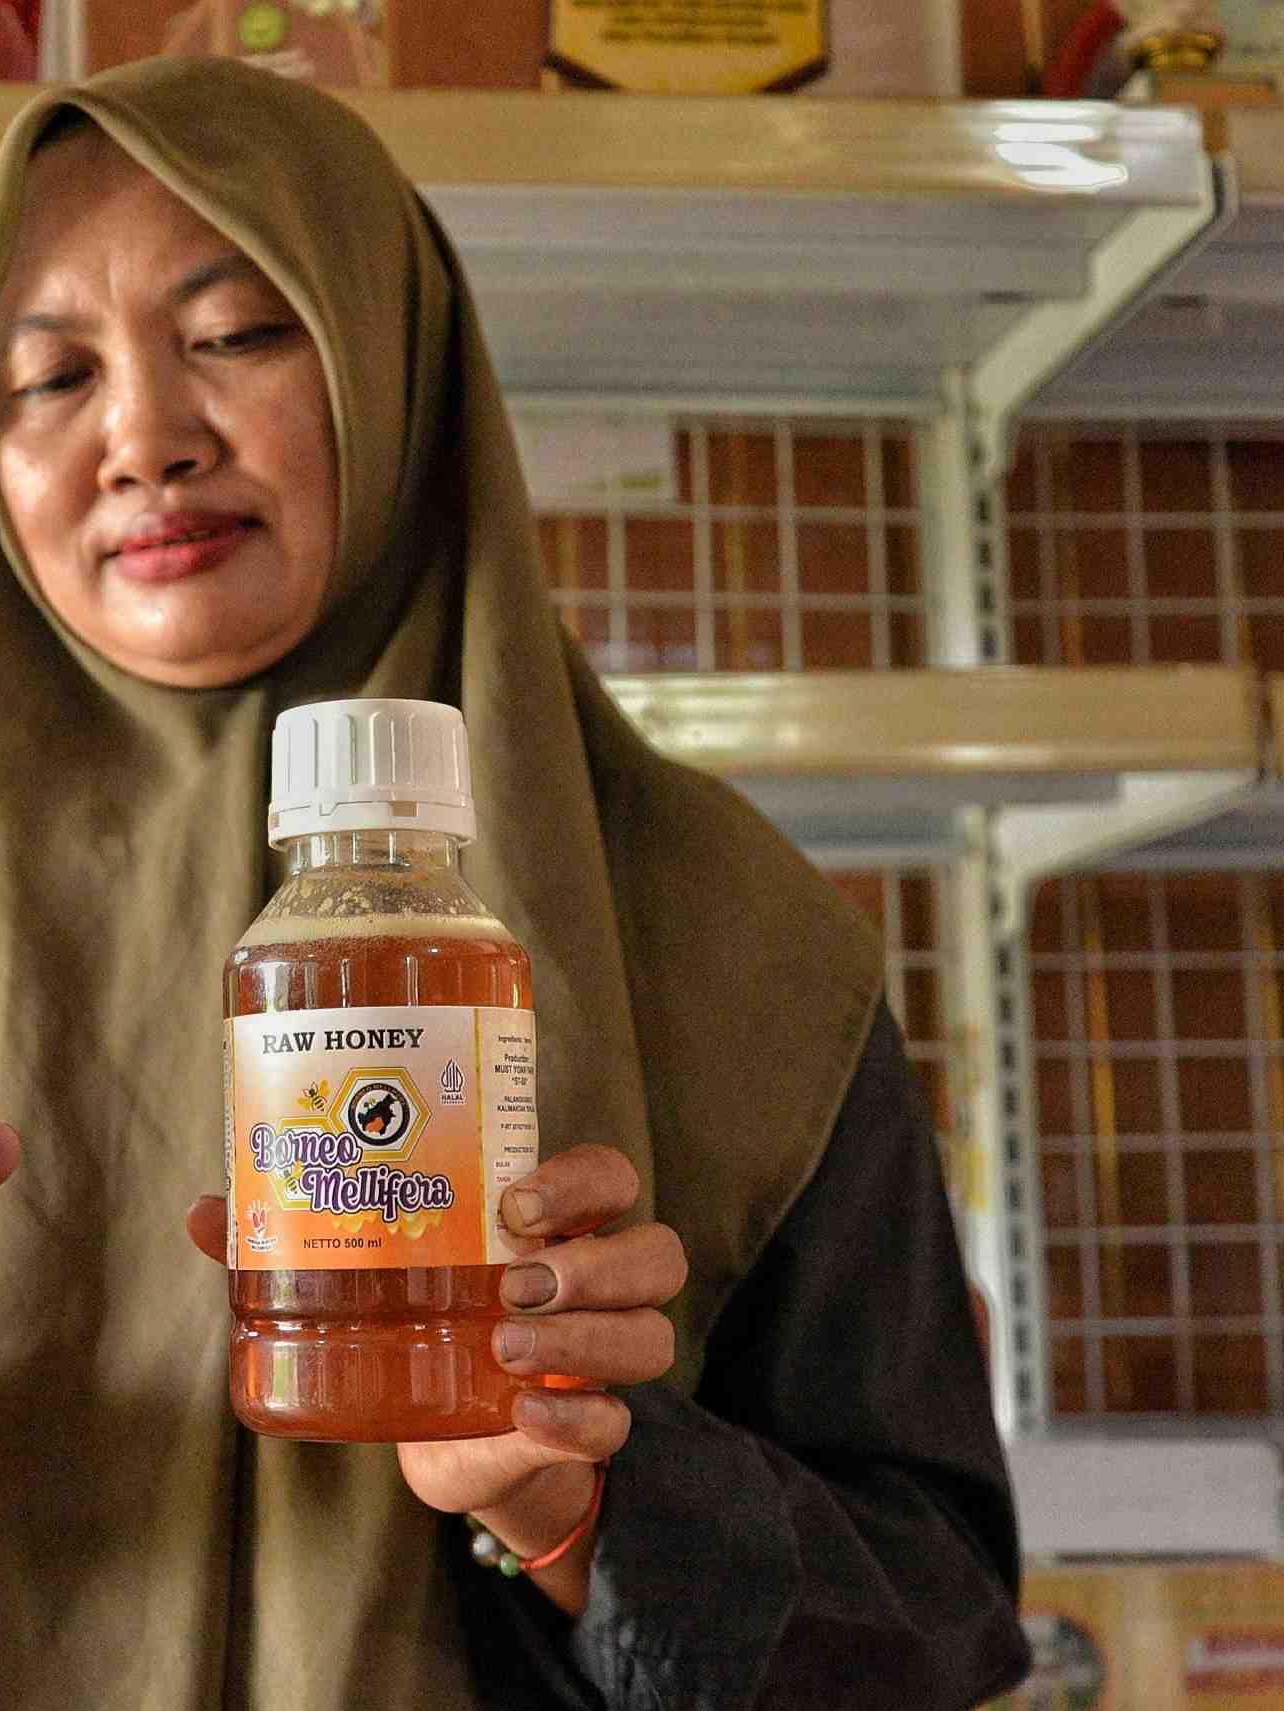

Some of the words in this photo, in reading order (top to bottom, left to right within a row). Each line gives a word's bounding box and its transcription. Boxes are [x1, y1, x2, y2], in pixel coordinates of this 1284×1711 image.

[262, 1031, 316, 1054] RAW
[324, 1029, 424, 1051] HONEY
[252, 1124, 362, 1171] Borneo
[300, 1166, 452, 1221] Mellifera
[303, 1239, 341, 1249] NETTO
[344, 1238, 364, 1249] 500
[367, 1238, 382, 1248] ml
